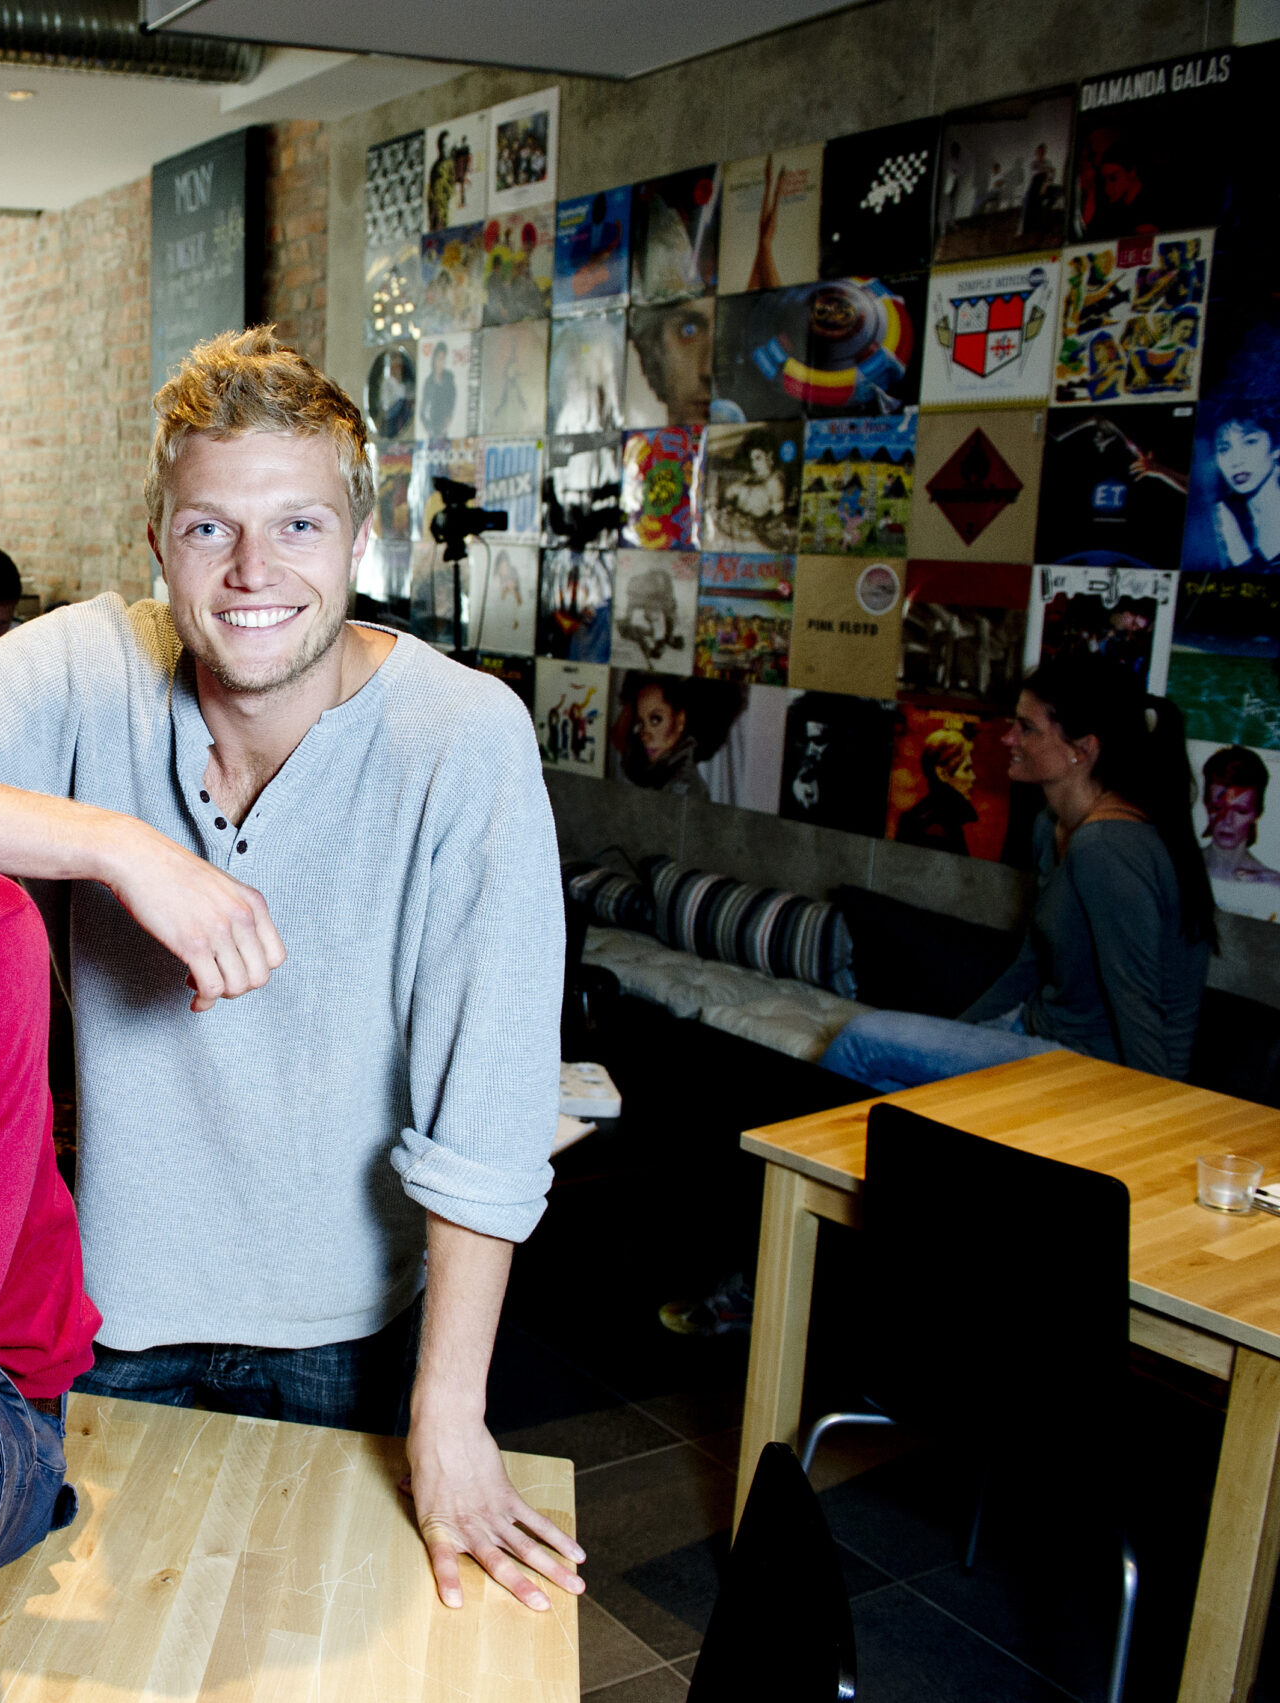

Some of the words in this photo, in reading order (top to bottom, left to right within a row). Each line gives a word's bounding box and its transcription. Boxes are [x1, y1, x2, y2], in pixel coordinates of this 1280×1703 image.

[1080, 67, 1167, 112] DIAMANDA
[1171, 54, 1231, 92] GALAS
[807, 618, 834, 632] PINK
